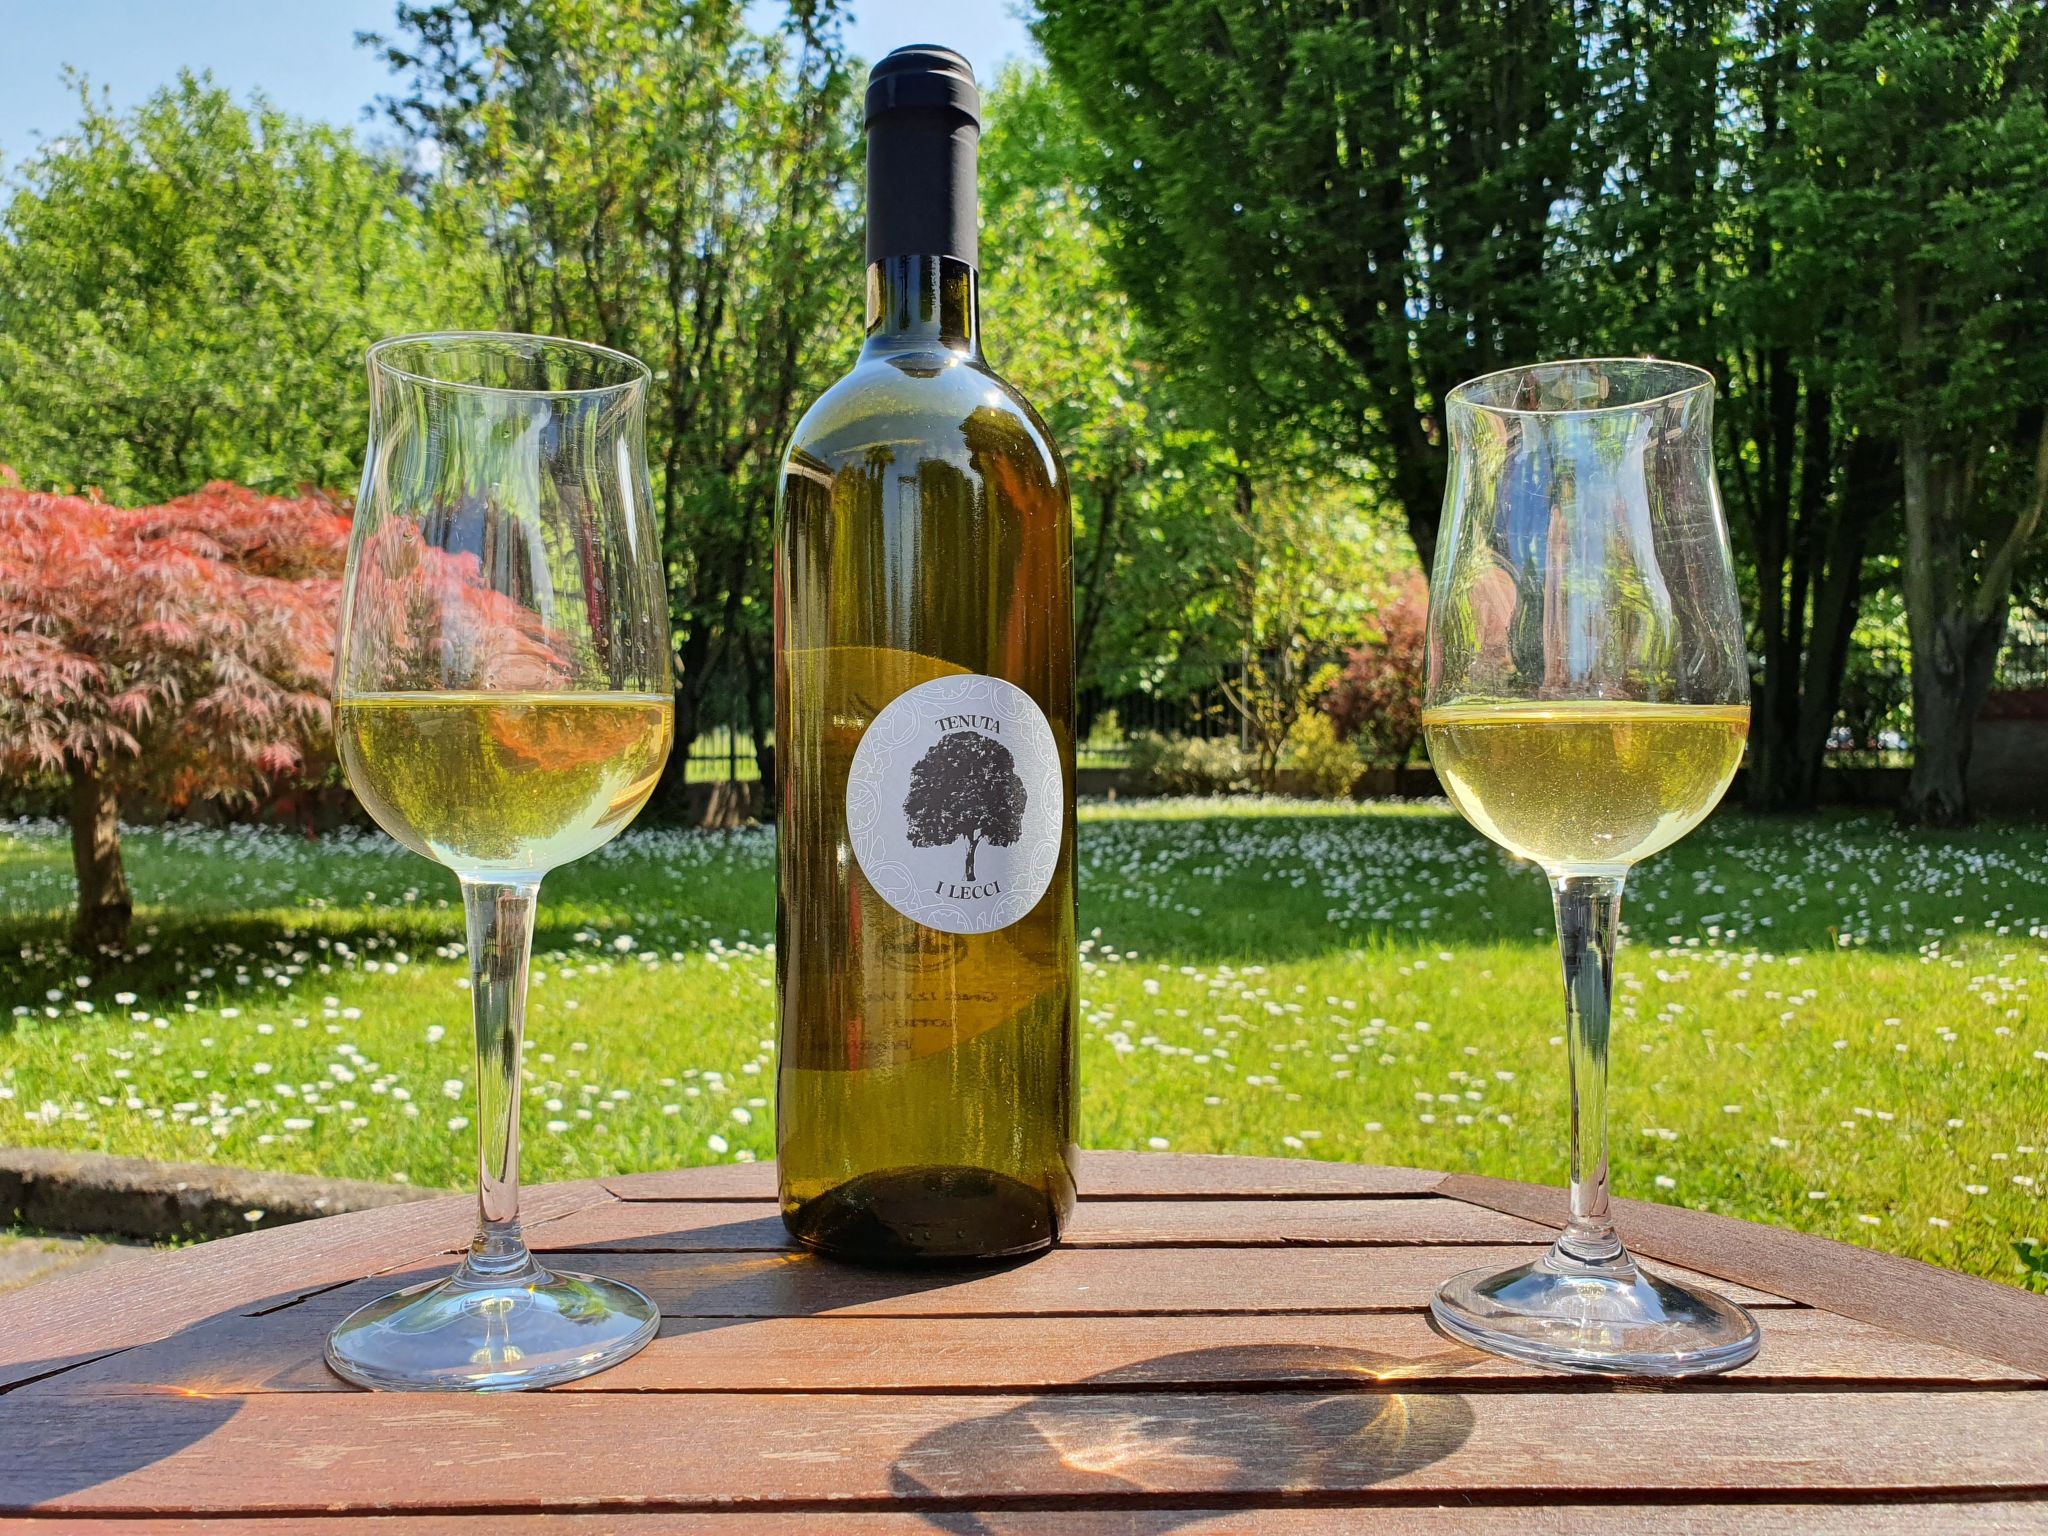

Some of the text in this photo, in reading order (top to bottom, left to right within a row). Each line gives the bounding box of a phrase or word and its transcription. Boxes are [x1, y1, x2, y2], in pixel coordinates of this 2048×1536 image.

[935, 714, 1000, 734] TENUTA
[935, 880, 1001, 900] I LECCI
